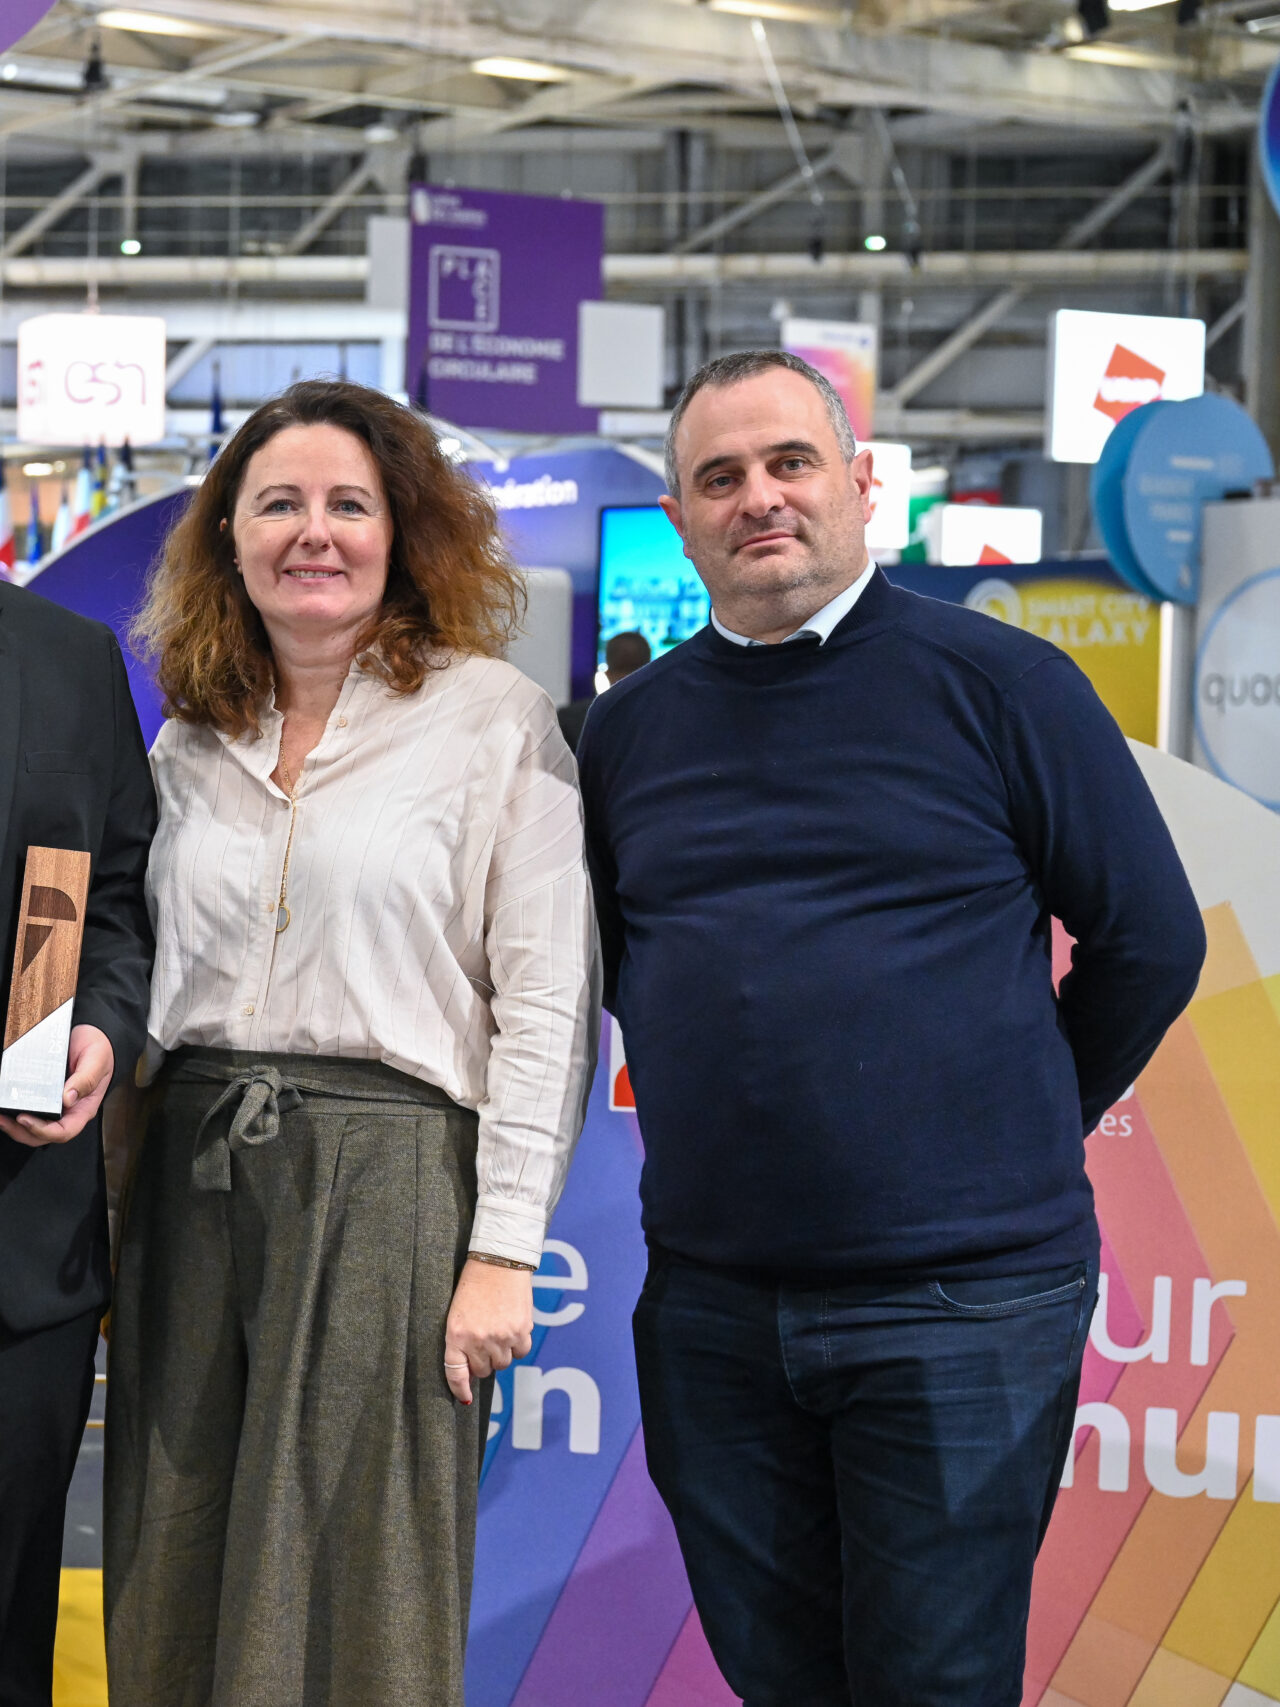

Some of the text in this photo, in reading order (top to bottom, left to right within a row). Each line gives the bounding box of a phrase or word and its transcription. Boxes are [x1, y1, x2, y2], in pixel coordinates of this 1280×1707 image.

[1204, 672, 1280, 716] quo
[1090, 1272, 1247, 1366] ur
[487, 1366, 602, 1455] n
